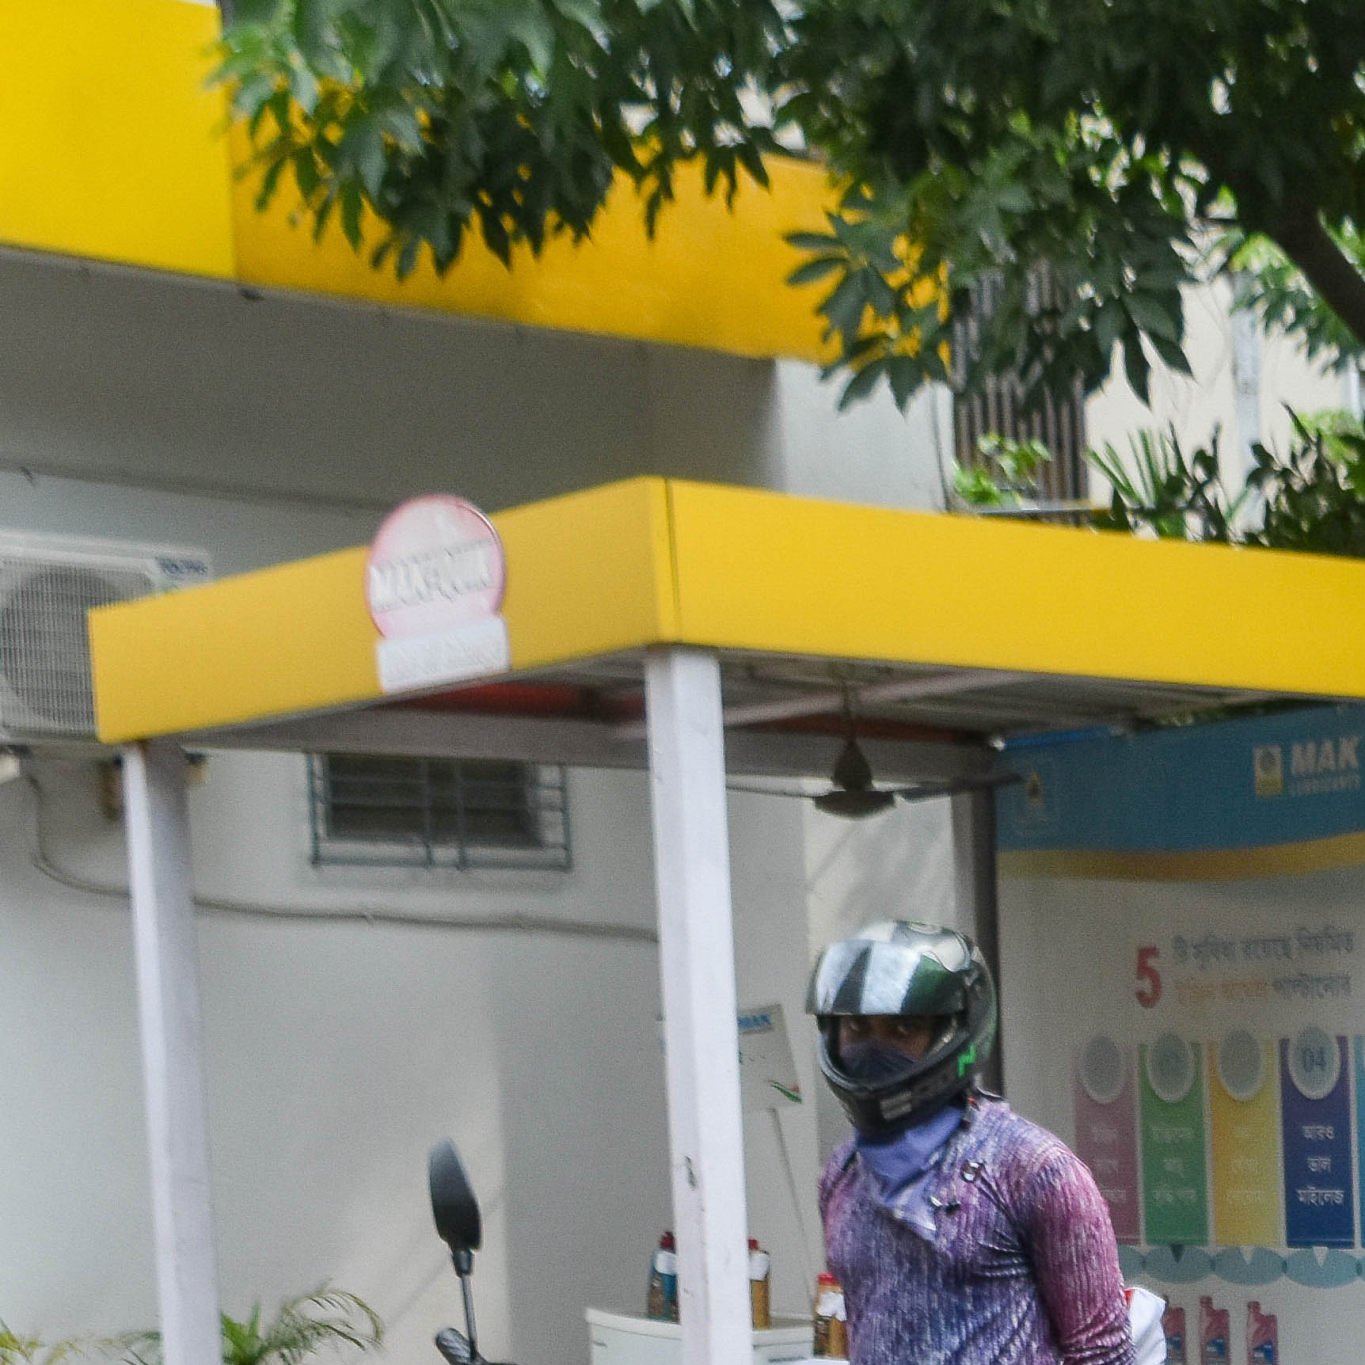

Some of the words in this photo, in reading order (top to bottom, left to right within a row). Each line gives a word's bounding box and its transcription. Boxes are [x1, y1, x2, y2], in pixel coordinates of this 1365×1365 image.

[1291, 735, 1361, 775] MAK
[1135, 943, 1163, 1010] 5
[1302, 1047, 1327, 1074] 04
